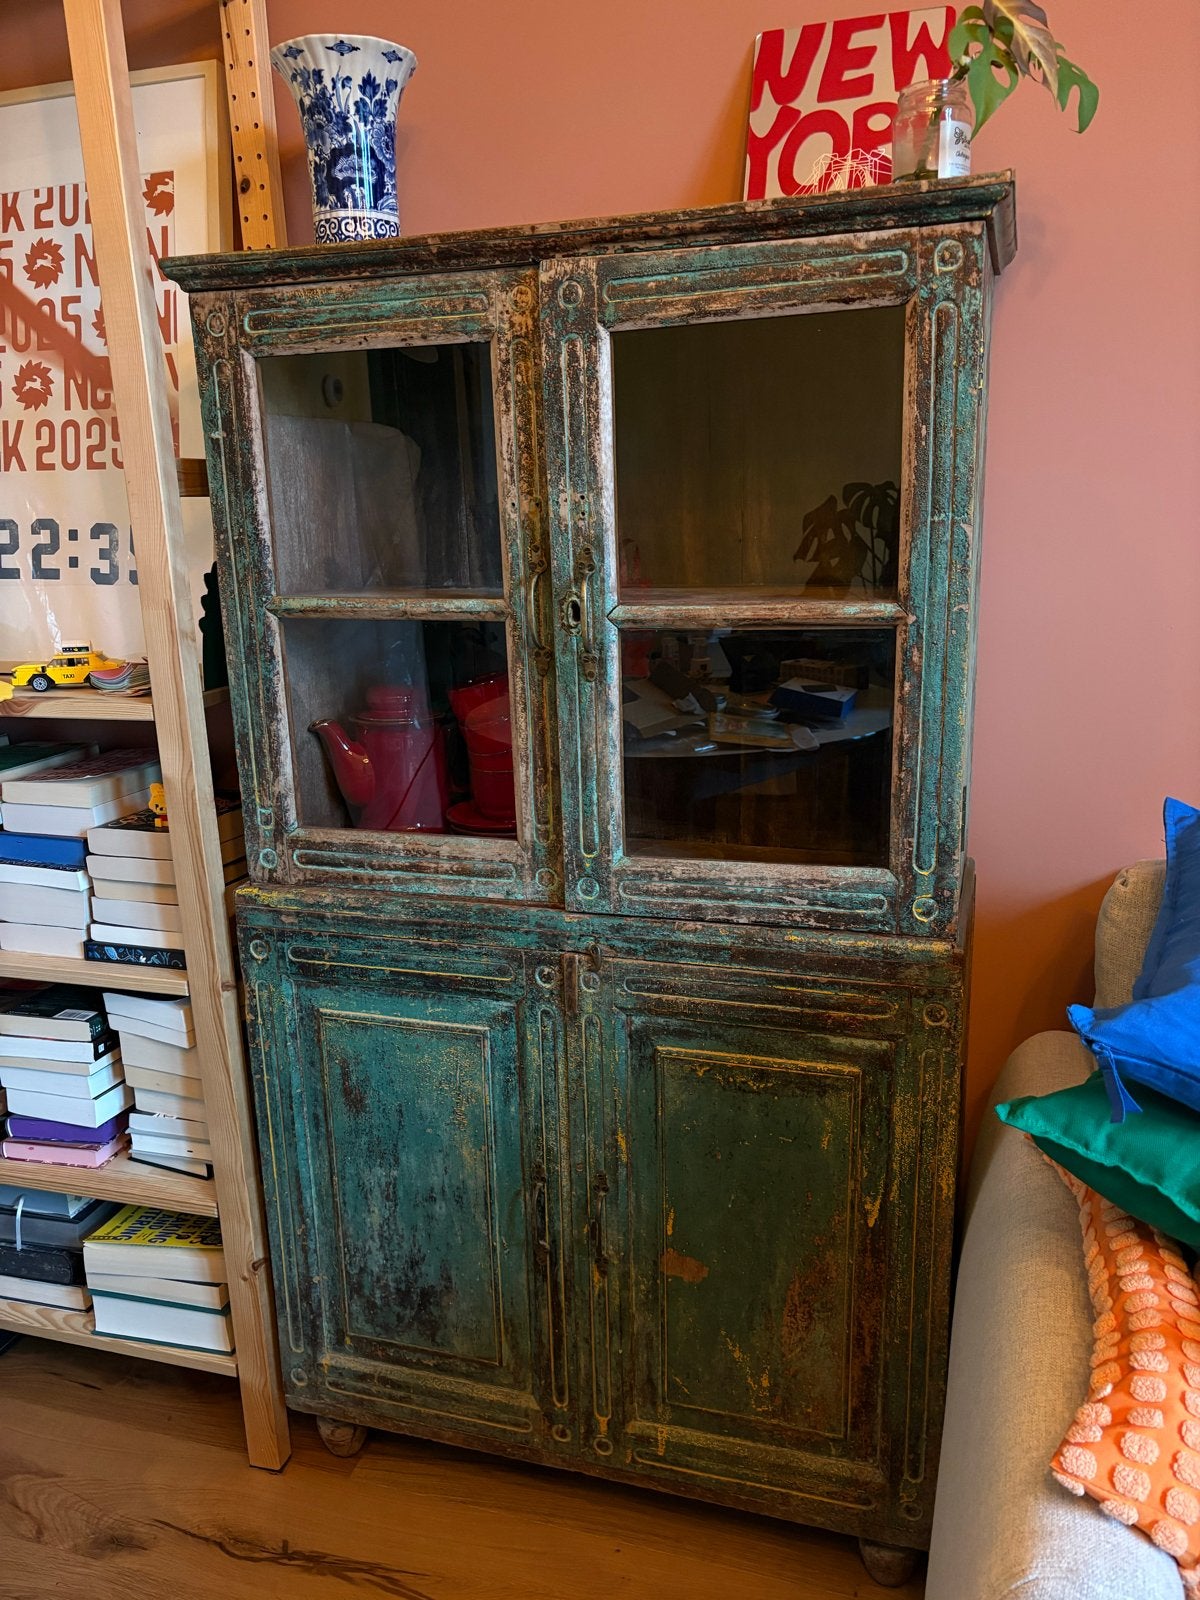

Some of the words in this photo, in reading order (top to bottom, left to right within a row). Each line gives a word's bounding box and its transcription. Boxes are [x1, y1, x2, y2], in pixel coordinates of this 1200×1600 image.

[750, 6, 956, 112] NEW
[747, 102, 897, 201] YOR
[0, 518, 138, 585] 22:3
